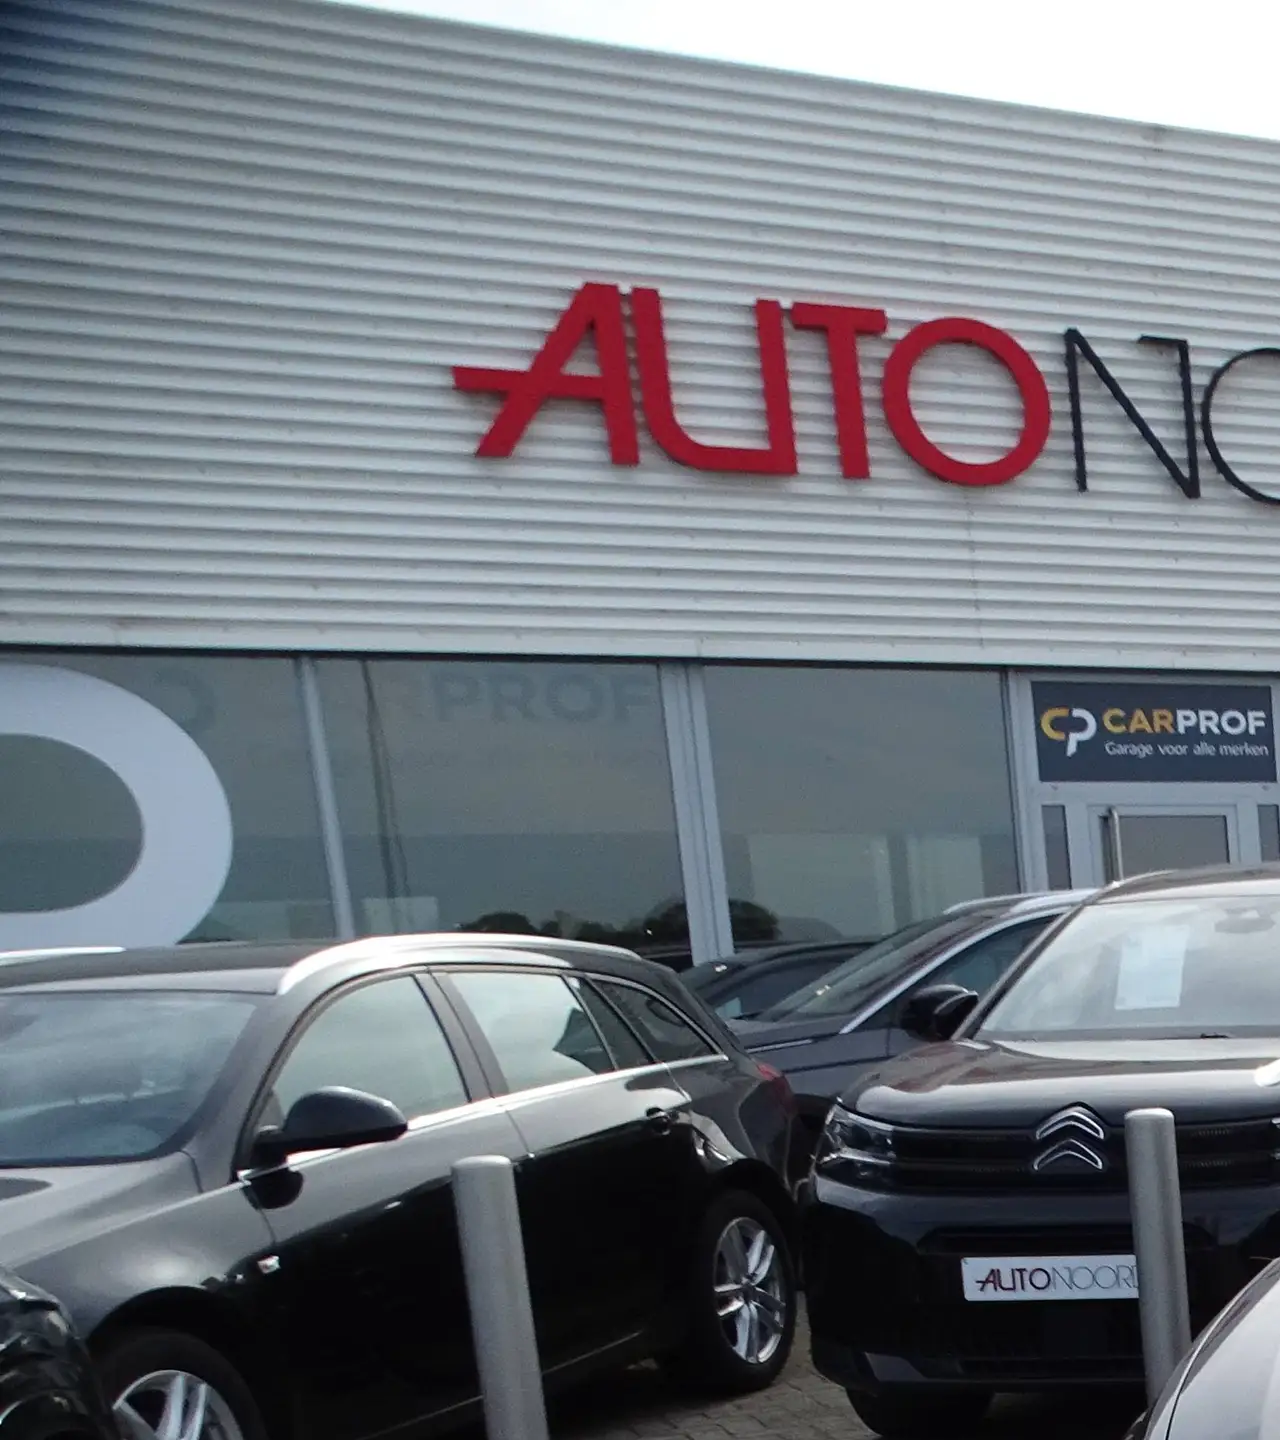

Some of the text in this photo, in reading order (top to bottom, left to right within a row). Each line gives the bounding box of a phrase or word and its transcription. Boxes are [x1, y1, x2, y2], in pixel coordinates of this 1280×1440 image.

[1103, 707, 1266, 736] CARPROF
[1104, 740, 1269, 759] Garage voor alle merken
